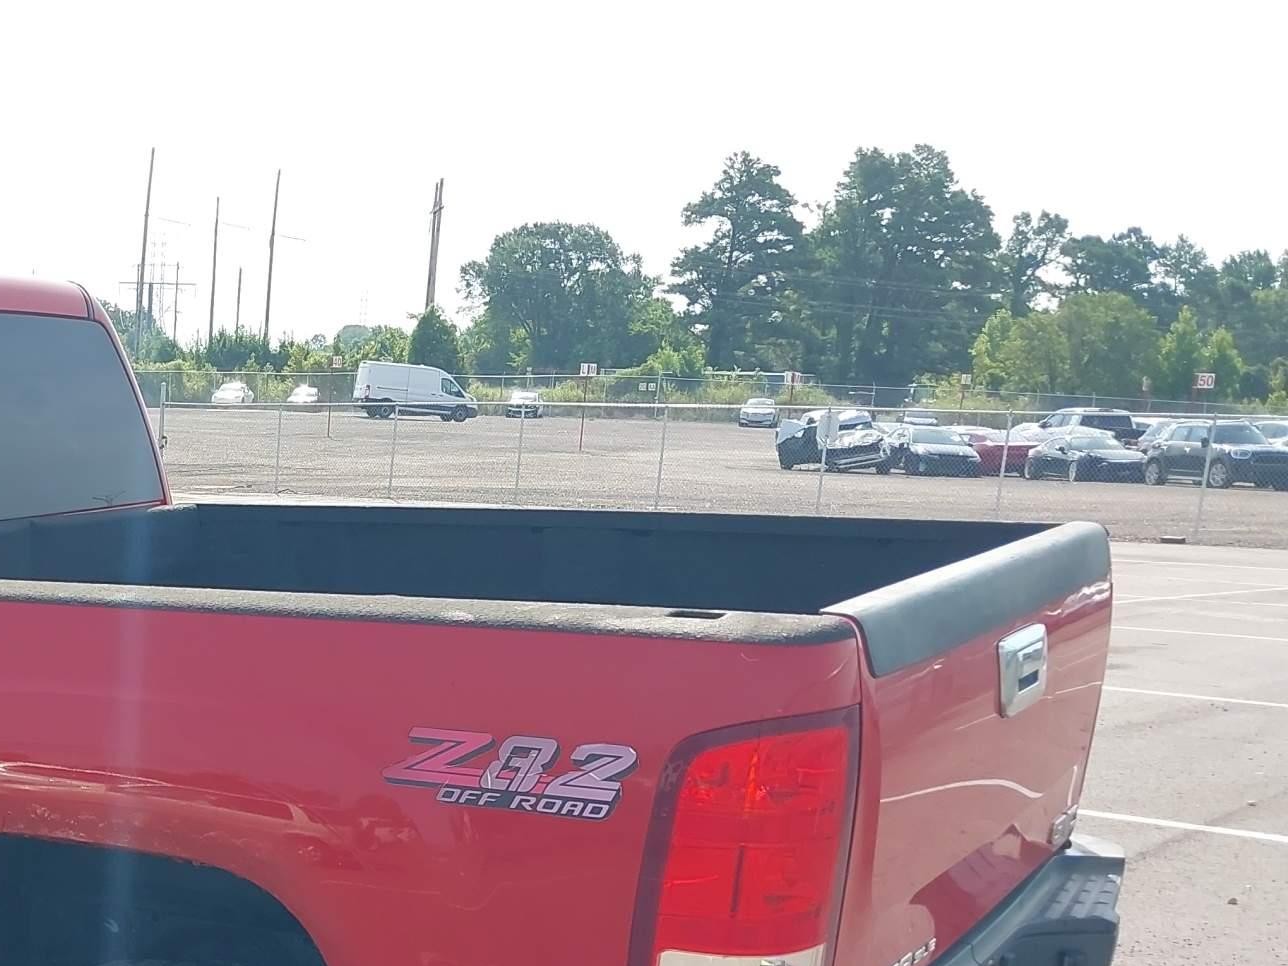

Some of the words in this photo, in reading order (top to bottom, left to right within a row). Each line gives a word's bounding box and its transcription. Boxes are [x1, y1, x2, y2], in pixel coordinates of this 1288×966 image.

[1198, 374, 1214, 387] 50
[437, 786, 499, 805] OFF
[509, 794, 611, 820] ROAD
